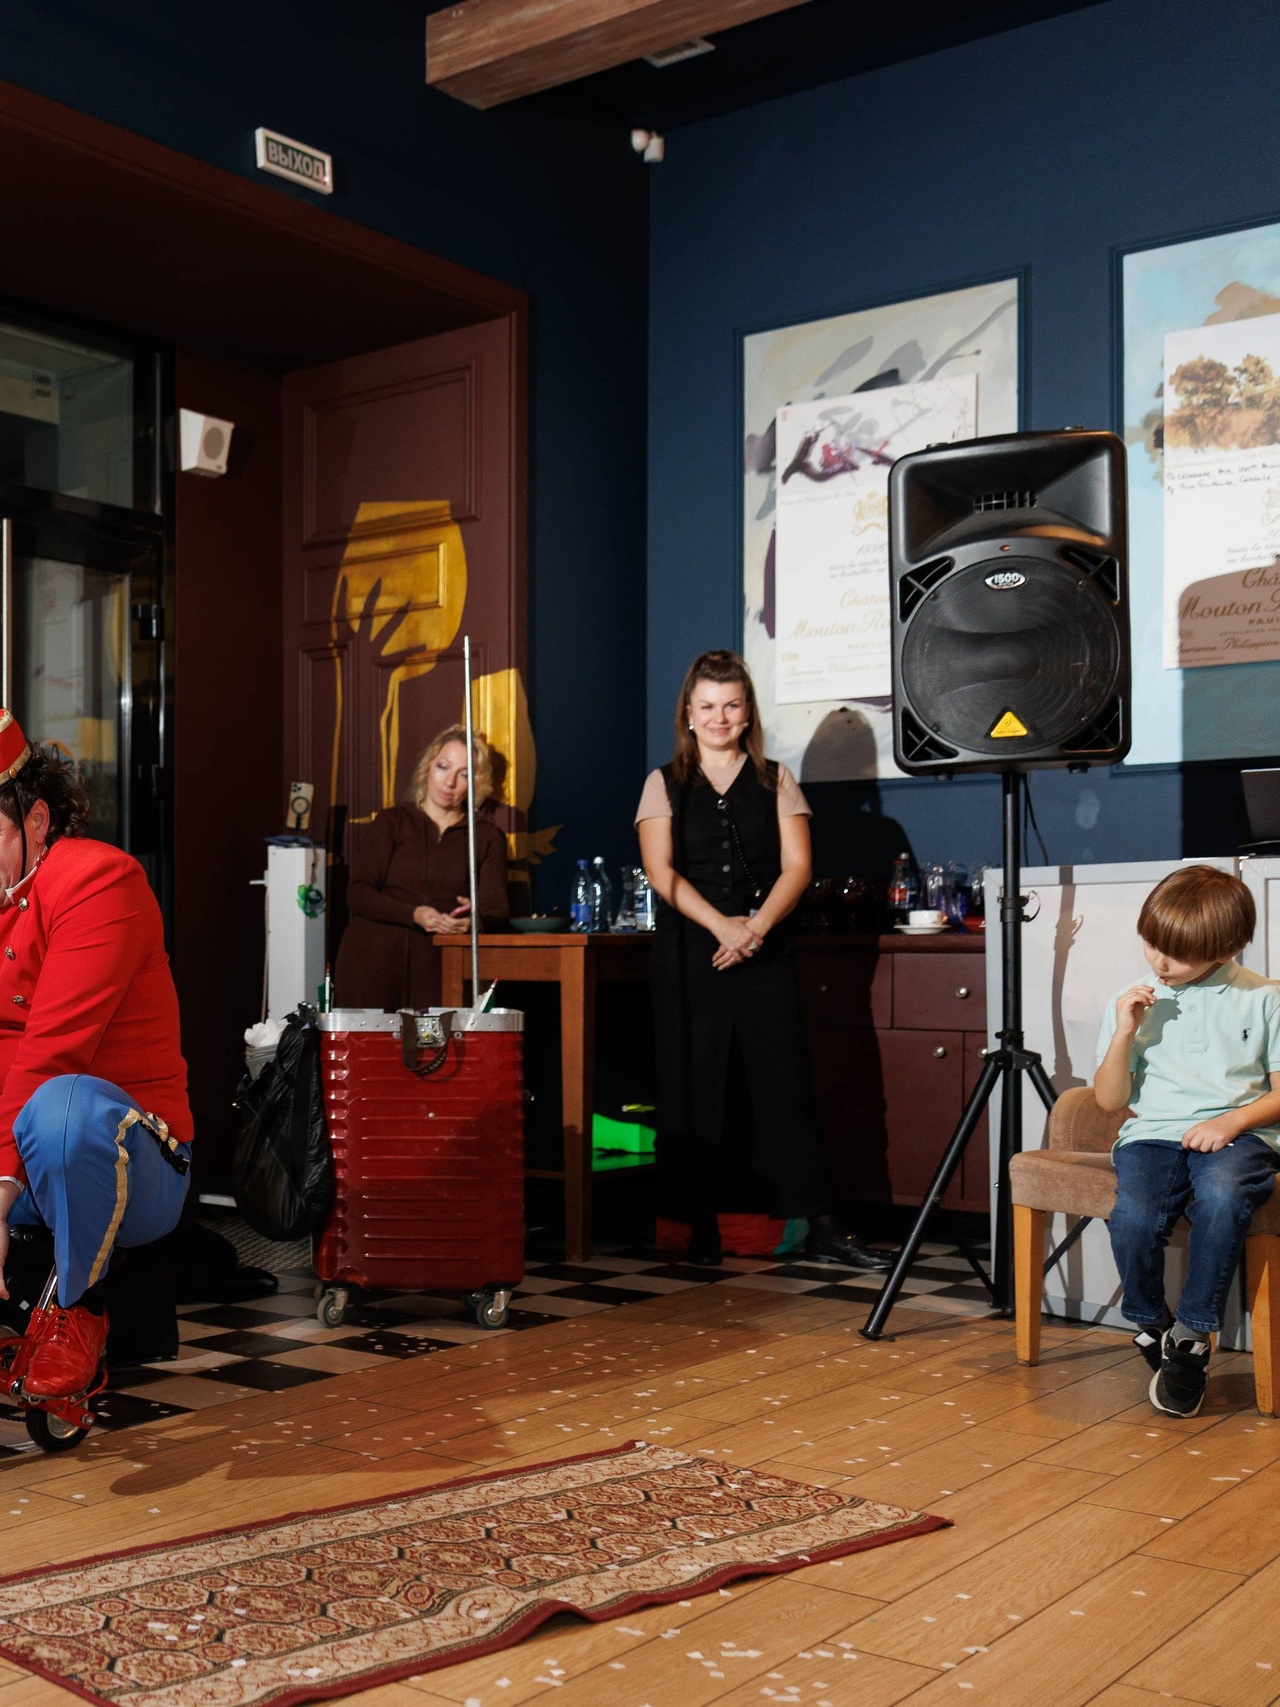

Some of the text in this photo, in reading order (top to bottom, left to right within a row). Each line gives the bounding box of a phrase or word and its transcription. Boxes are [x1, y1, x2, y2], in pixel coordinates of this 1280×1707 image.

[267, 140, 324, 181] ВЫХОД
[994, 572, 1020, 584] 1500
[1178, 596, 1261, 620] Mouton
